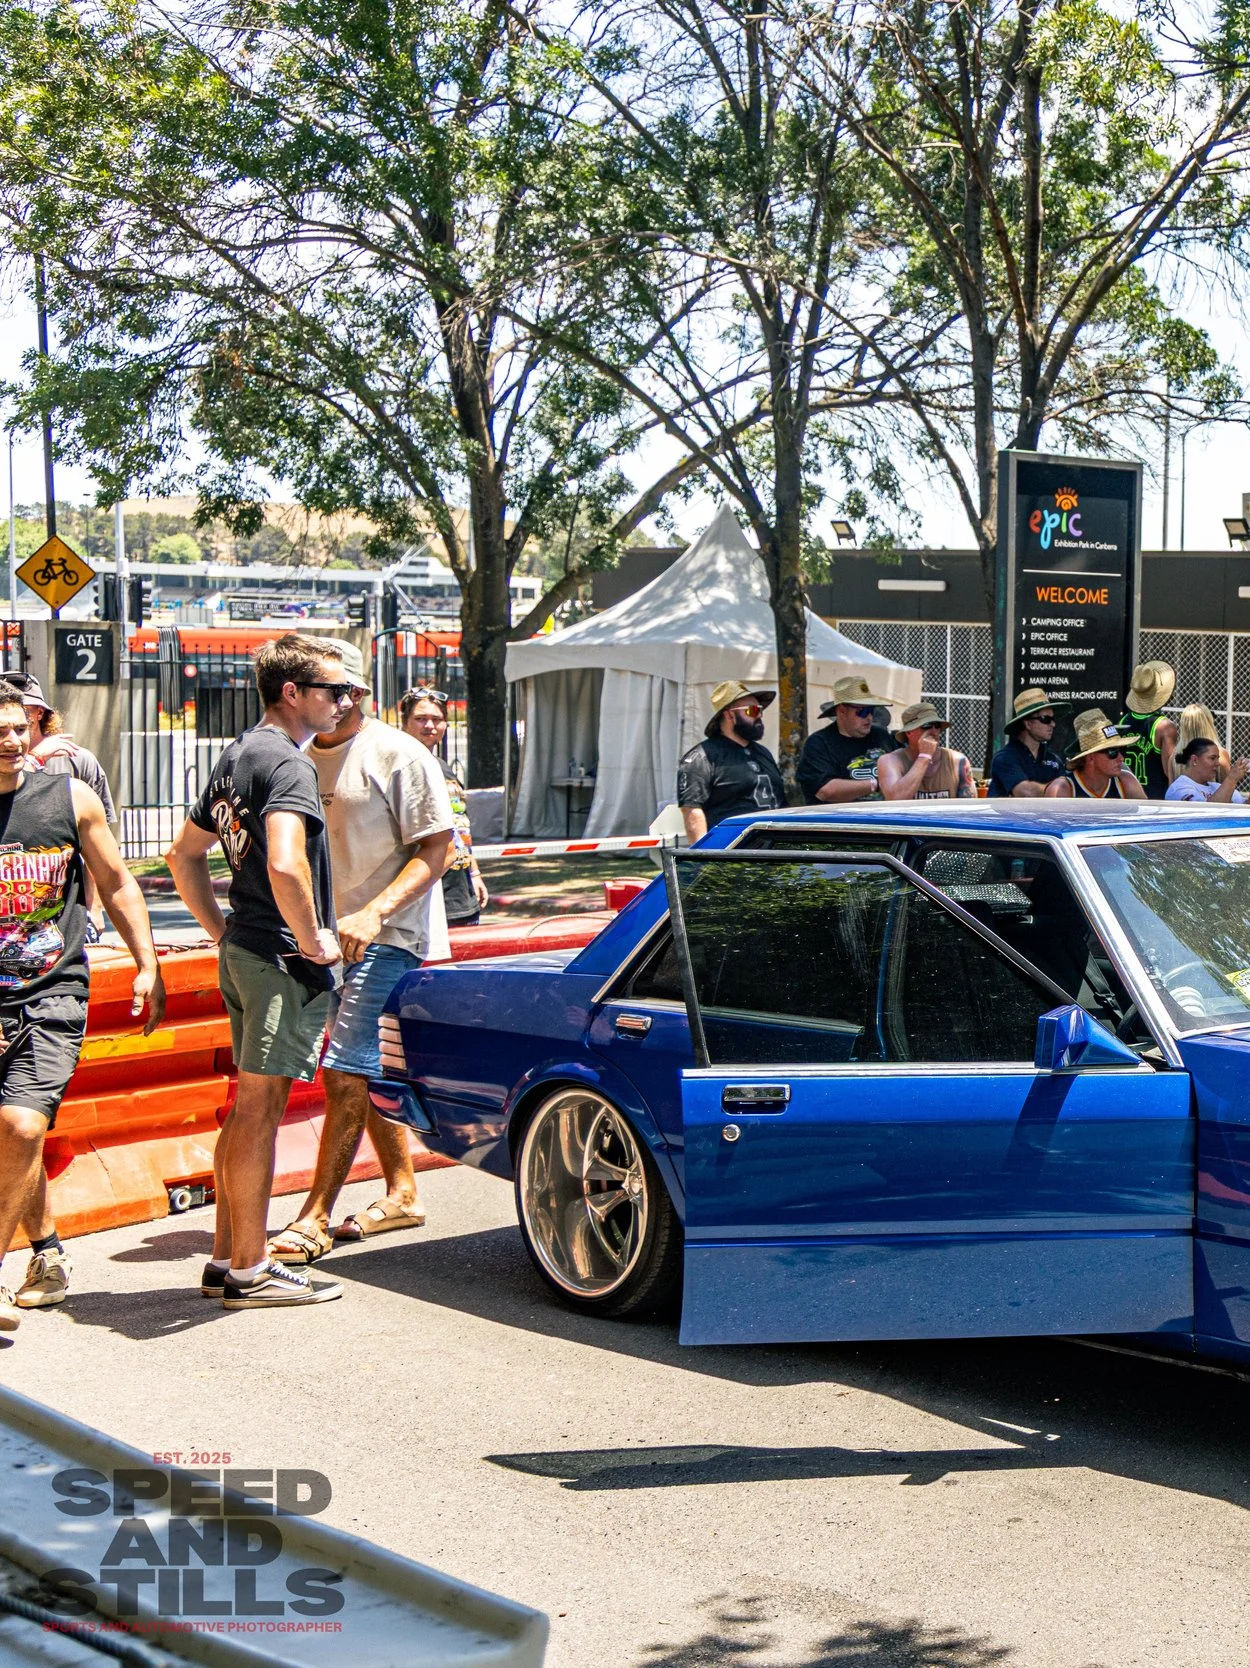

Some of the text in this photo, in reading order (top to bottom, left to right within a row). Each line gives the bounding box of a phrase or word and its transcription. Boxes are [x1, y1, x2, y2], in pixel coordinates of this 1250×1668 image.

[1029, 509, 1083, 550] epic
[1054, 539, 1118, 551] Exhibition Park in Canberra
[1036, 586, 1109, 605] WELCOME
[1031, 617, 1085, 628] CAMPING OFFICE
[66, 633, 102, 648] GATE
[1030, 632, 1068, 642] EPIC OFFICE
[1030, 647, 1095, 657] TERRACE RESTAURANT
[76, 648, 97, 681] 2
[1029, 662, 1086, 671] QUOKKA PAVILION
[1029, 677, 1069, 685] MAIN ARENA
[1071, 691, 1096, 700] RACING
[1096, 691, 1118, 700] OFFICE
